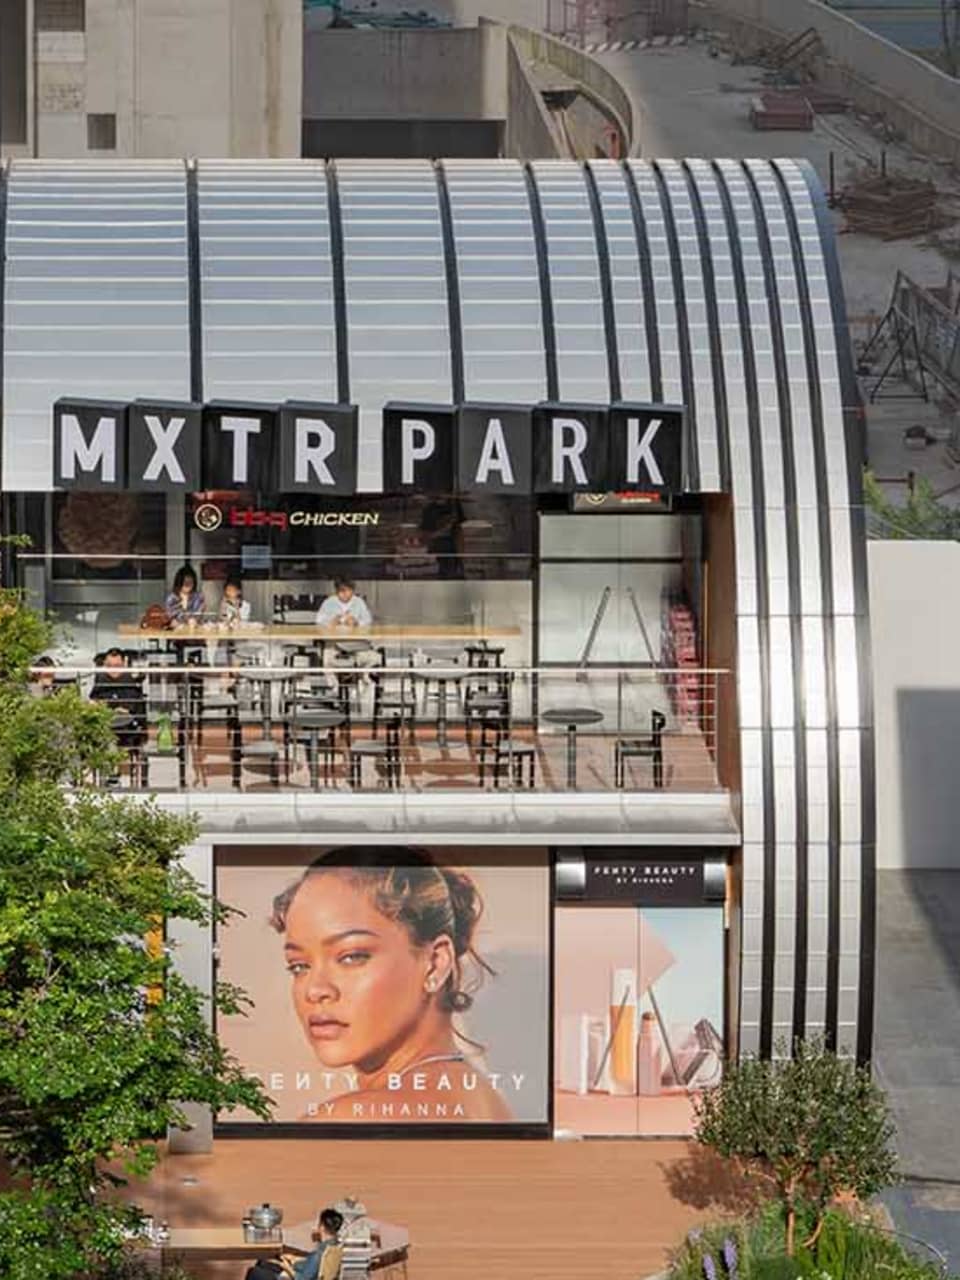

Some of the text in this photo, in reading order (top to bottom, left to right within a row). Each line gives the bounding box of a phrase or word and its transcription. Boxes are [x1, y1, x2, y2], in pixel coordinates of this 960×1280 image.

[61, 414, 665, 484] MXTR PARK
[290, 511, 379, 526] CHICKEN
[645, 866, 695, 875] BEAUTY
[388, 1073, 525, 1090] BEAUTY
[307, 1102, 464, 1116] BY RIHANNA
